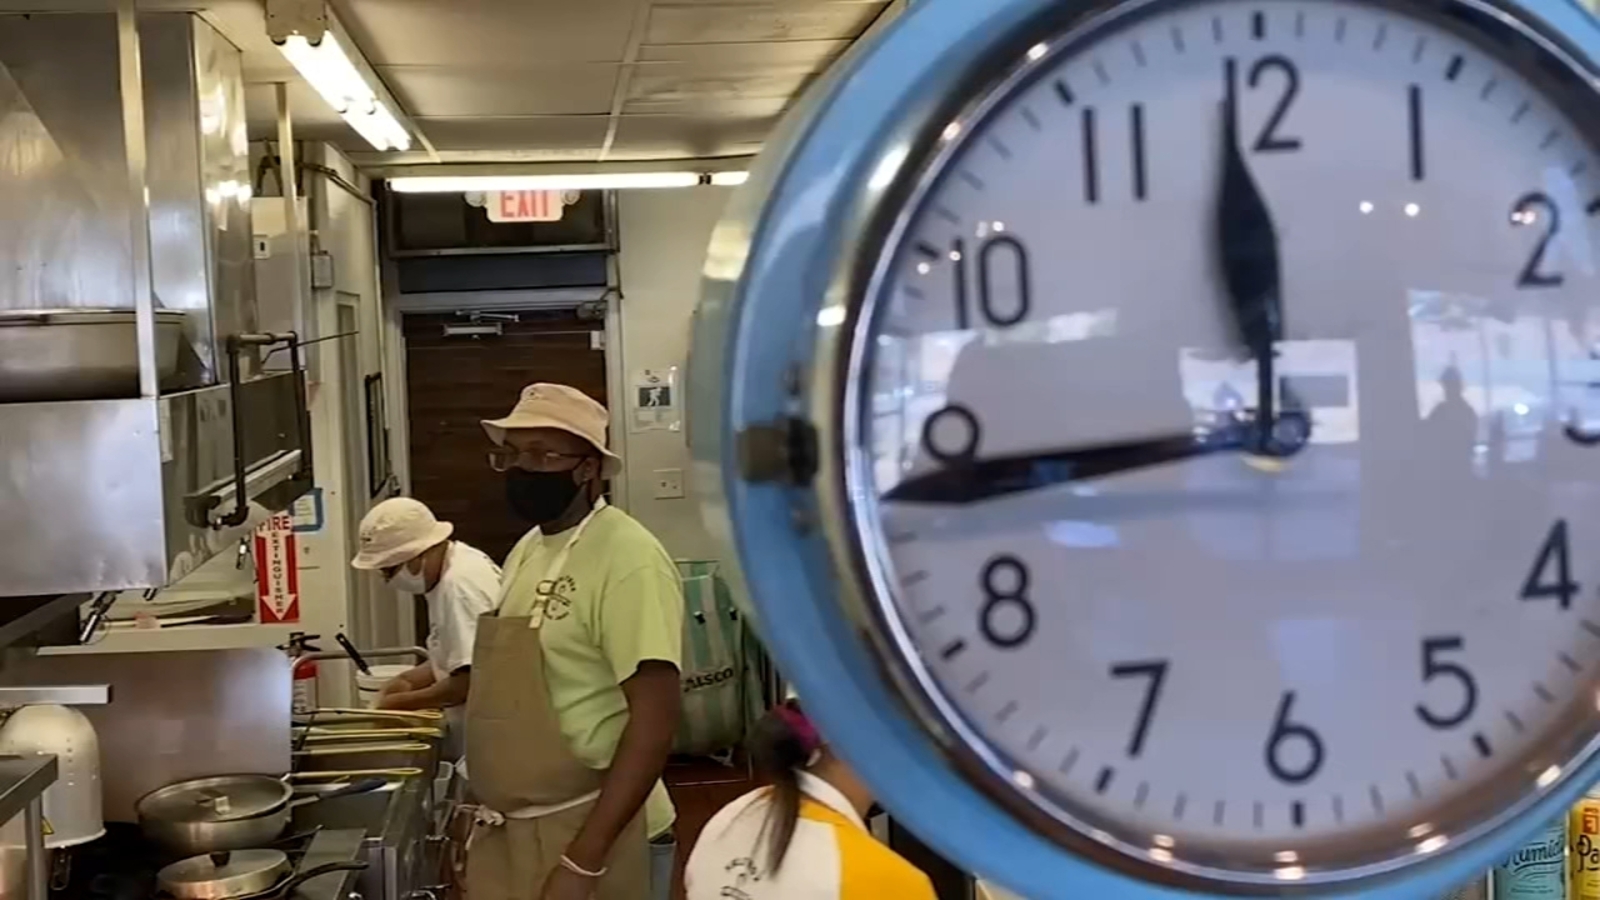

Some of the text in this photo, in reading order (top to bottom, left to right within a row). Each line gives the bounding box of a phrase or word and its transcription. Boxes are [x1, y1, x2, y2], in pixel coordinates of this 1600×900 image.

[1081, 103, 1147, 204] 11
[1408, 83, 1425, 181] 1
[951, 236, 1030, 330] 10
[1509, 192, 1564, 287] 2
[256, 515, 291, 532] FIRE
[1517, 519, 1581, 609] 4
[271, 532, 284, 613] EXTINGUISHER
[979, 553, 1036, 649] 8
[1109, 659, 1170, 758] 7
[1414, 635, 1478, 730] 5
[1265, 690, 1326, 785] 6
